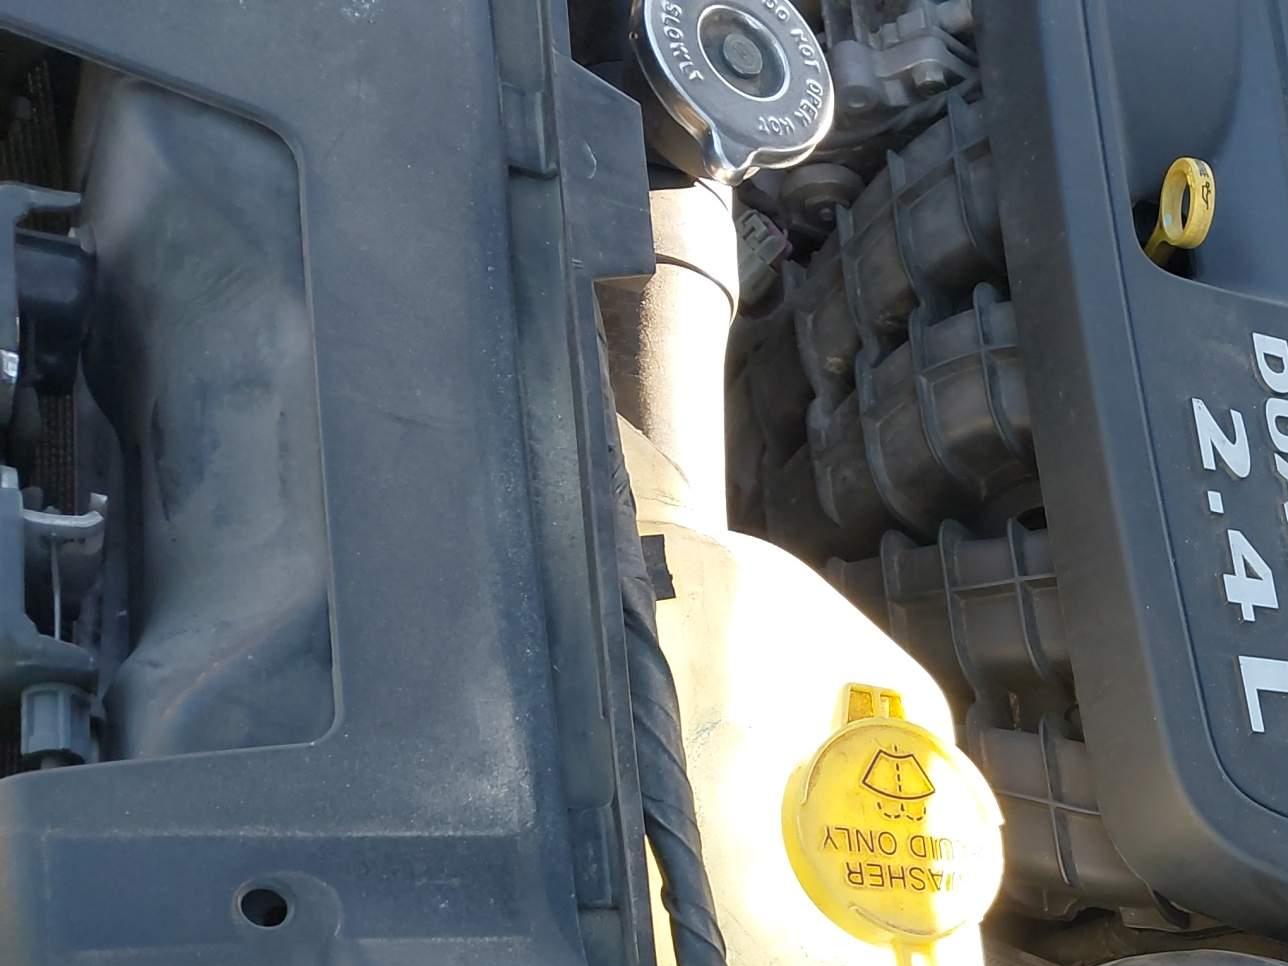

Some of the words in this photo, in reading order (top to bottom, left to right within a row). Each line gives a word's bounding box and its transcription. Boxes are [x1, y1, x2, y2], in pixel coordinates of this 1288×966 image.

[789, 28, 821, 73] NOT
[794, 79, 823, 127] OPEN
[758, 116, 795, 135] HOT
[822, 826, 898, 856] ONLY
